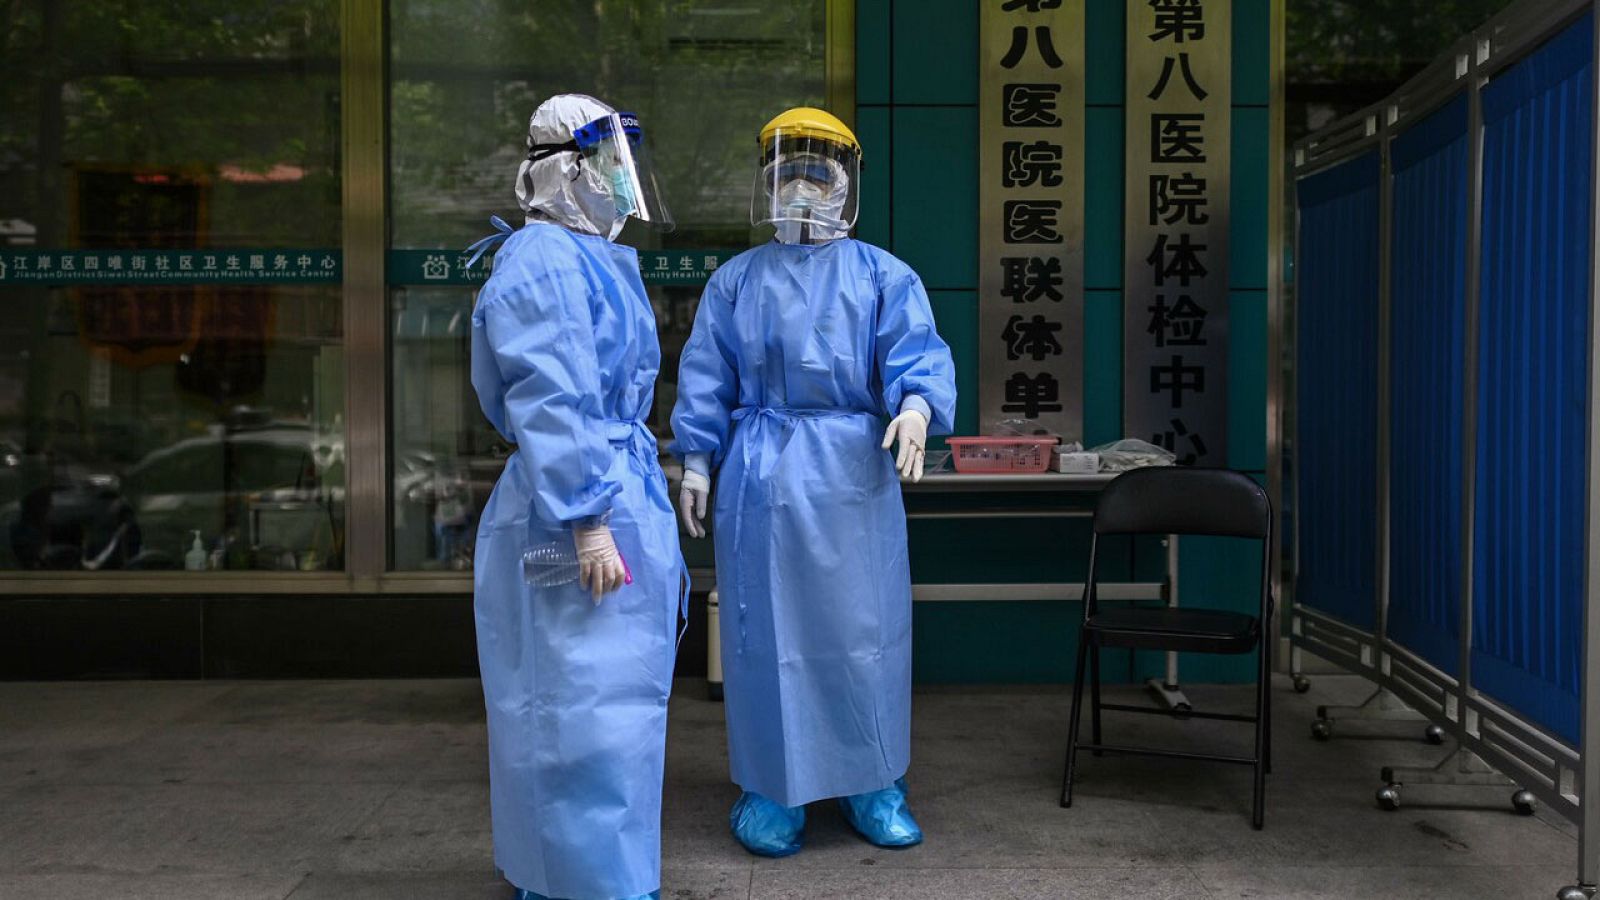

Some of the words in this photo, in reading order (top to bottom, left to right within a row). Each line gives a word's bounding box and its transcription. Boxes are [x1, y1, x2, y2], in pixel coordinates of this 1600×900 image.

[14, 255, 336, 270] 江岸区四唯街社区卫生服务中心
[1000, 0, 1065, 444] 八医院医联体单
[1147, 0, 1209, 466] 第八医院体检中心
